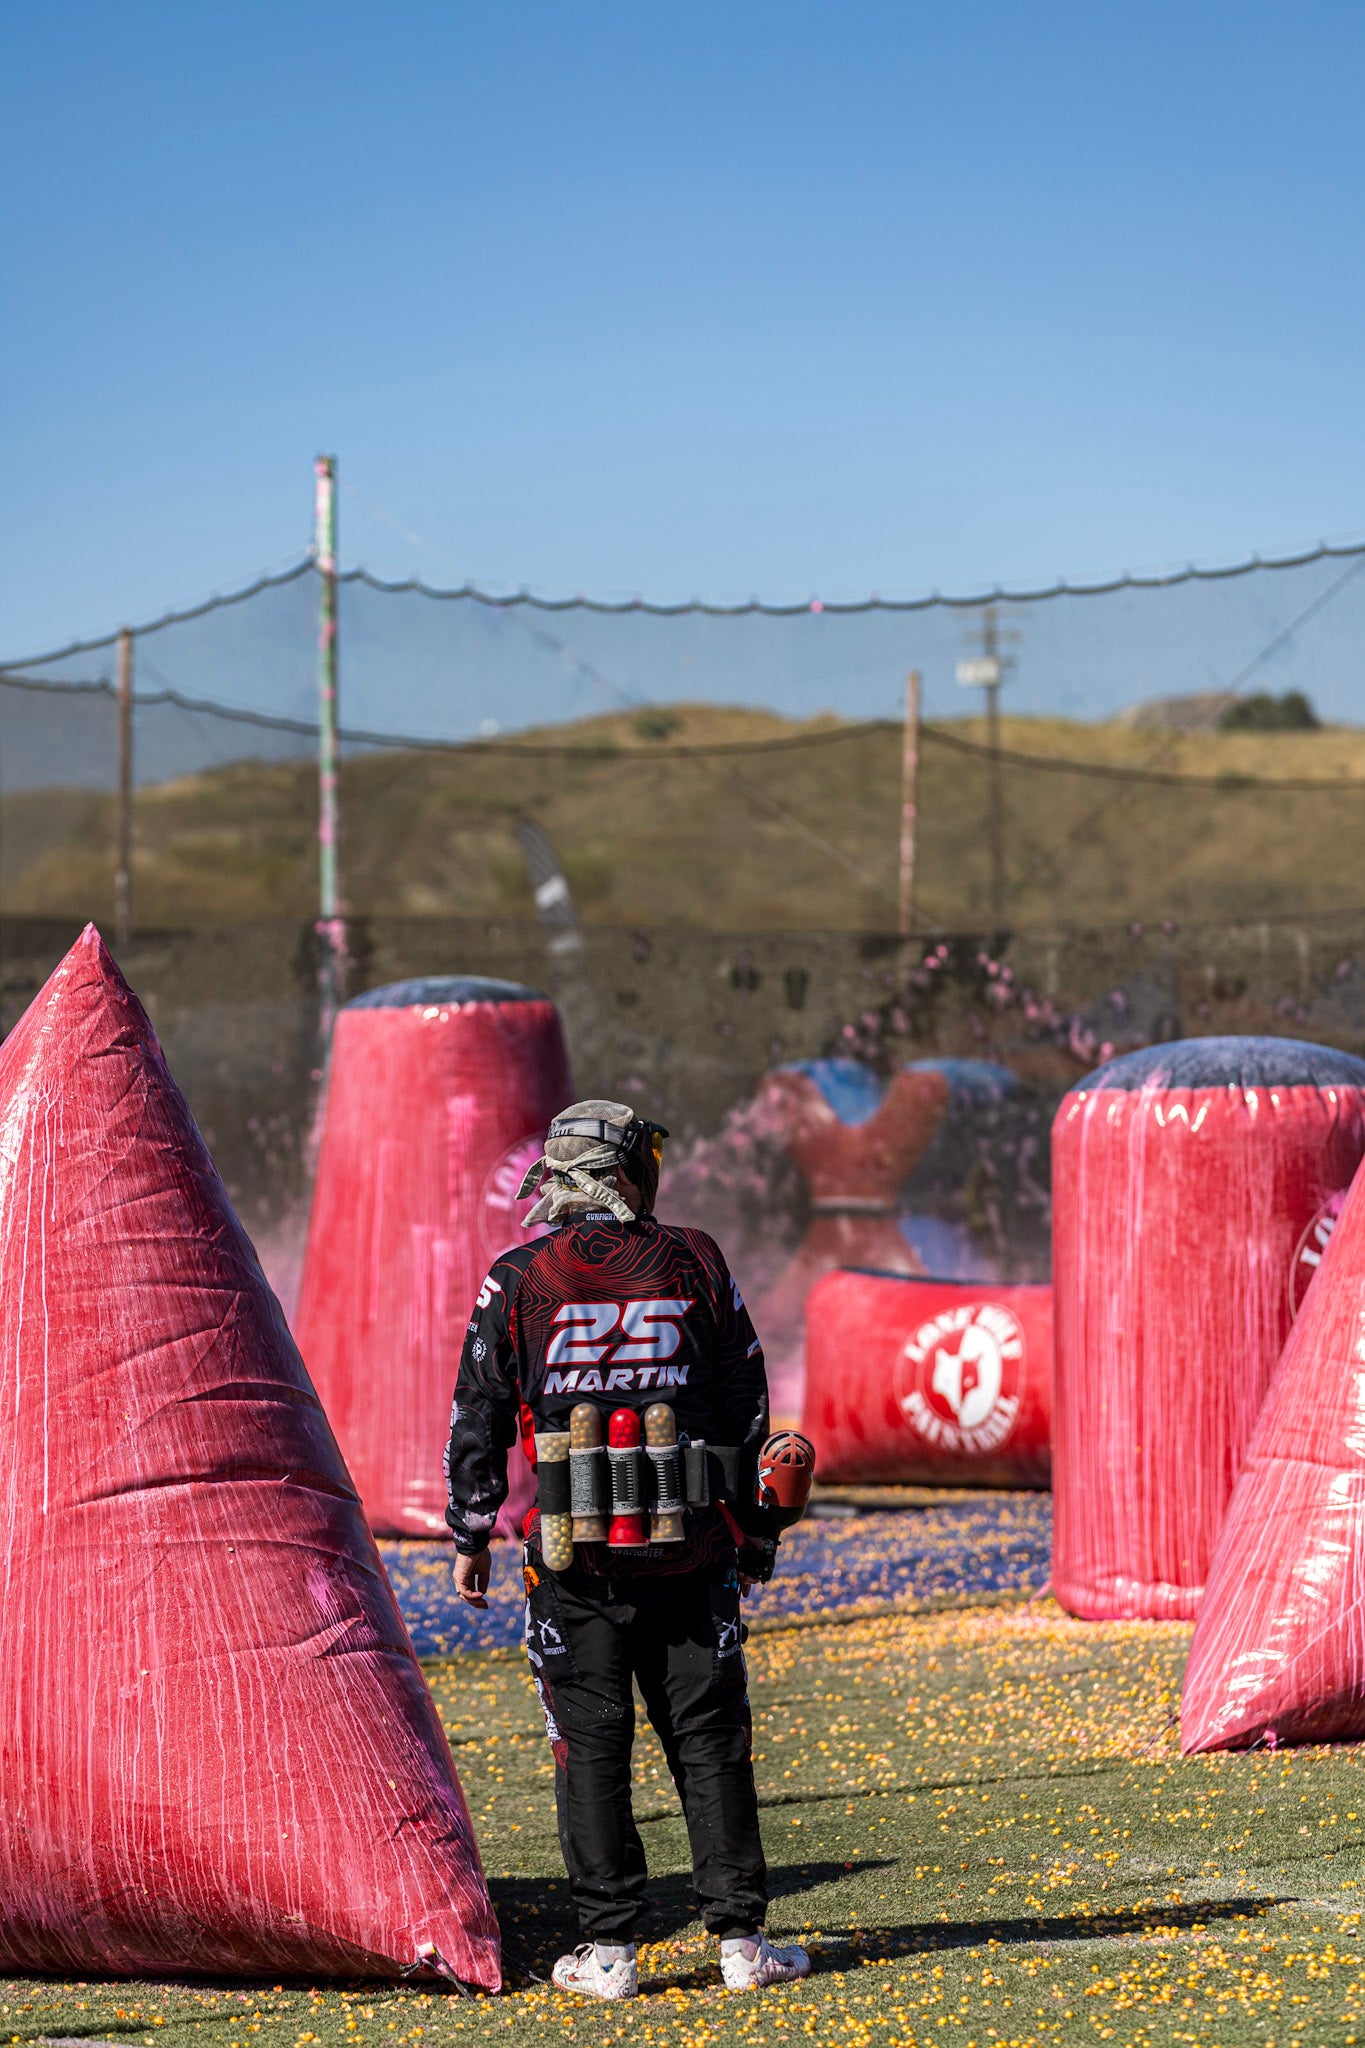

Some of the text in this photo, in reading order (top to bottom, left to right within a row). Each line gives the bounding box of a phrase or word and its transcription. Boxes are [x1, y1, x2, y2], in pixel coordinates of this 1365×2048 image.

[585, 1211, 619, 1221] GUNFIGHT
[545, 1299, 696, 1366] 25
[543, 1365, 690, 1395] MARTIN
